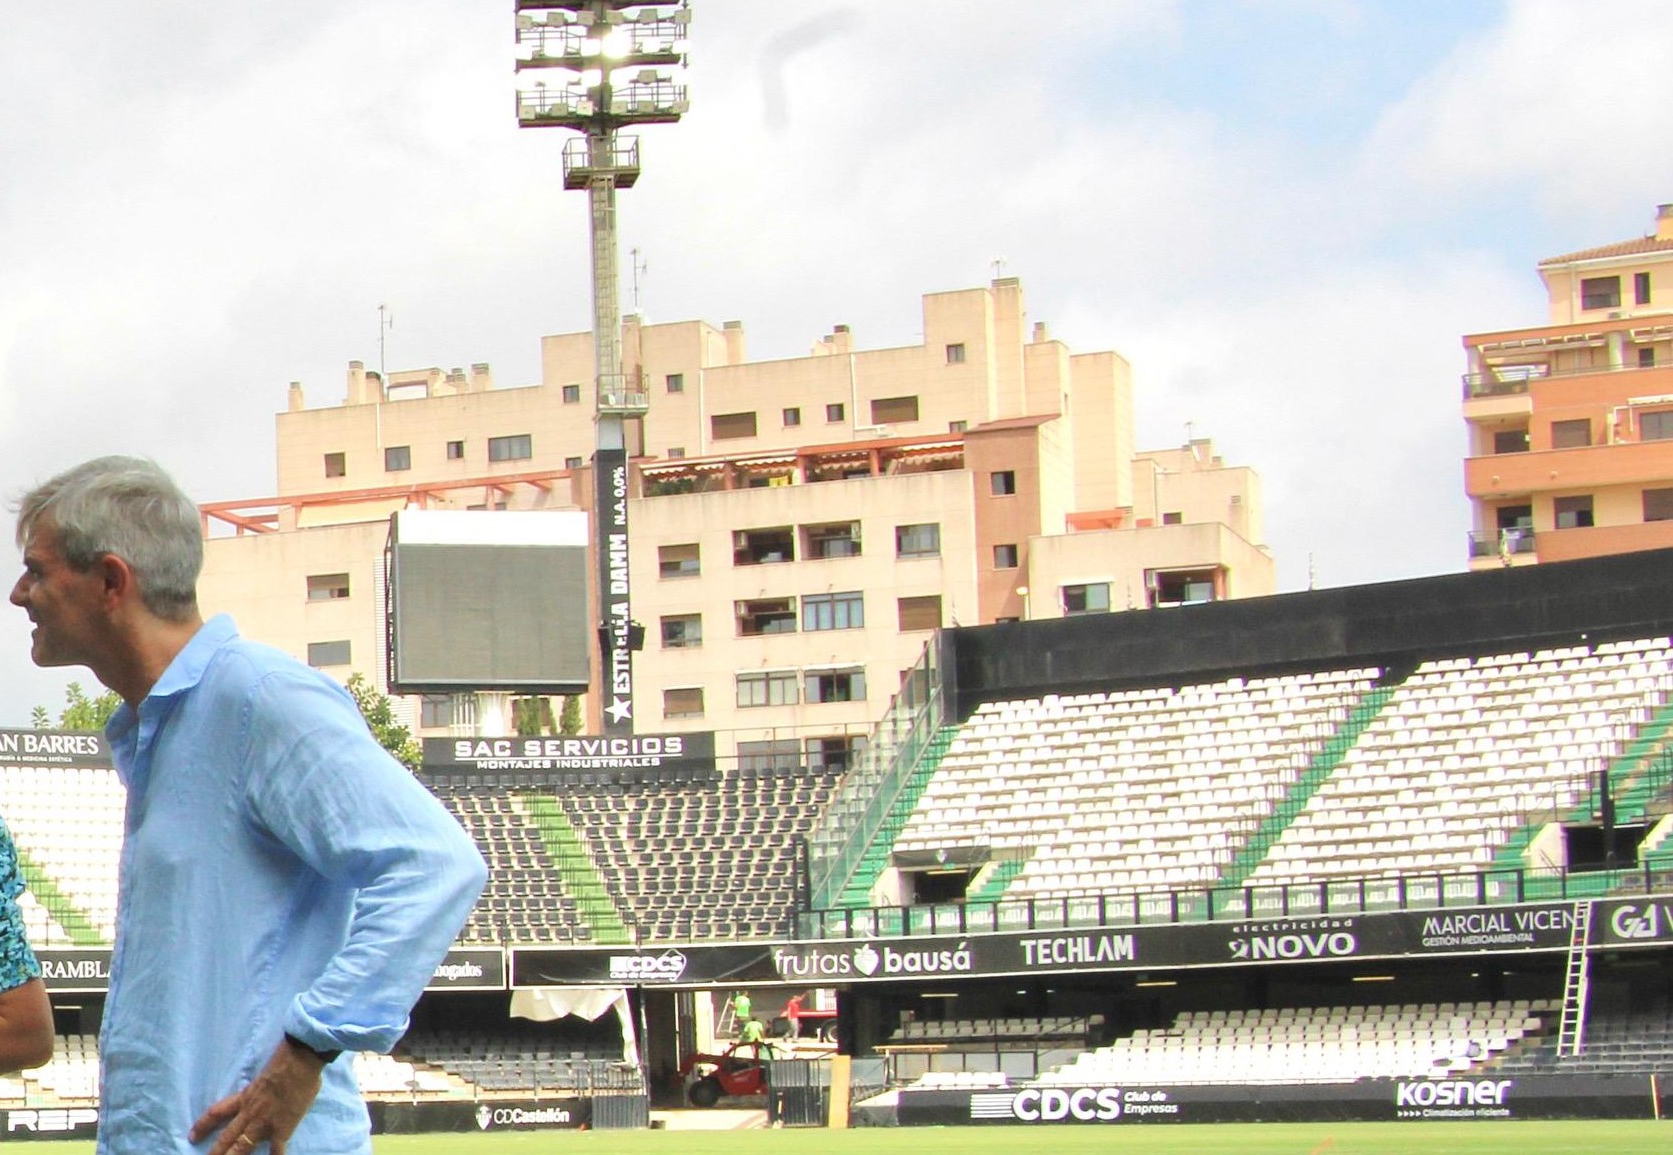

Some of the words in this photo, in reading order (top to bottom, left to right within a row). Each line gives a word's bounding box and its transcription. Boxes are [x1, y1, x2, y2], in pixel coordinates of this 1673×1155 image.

[613, 466, 627, 498] 0,0%
[614, 499, 626, 526] N.A.
[609, 534, 629, 595] DAMM
[23, 734, 99, 755] BARRES
[455, 740, 511, 757] SAC
[524, 736, 683, 757] SERVICIOS
[477, 759, 551, 770] MONTAJES
[556, 757, 661, 769] INDUSTRIALES
[1232, 919, 1353, 933] electricidad
[1422, 912, 1510, 936] MARCIAL
[1019, 934, 1135, 965] TECHLAM
[1251, 932, 1355, 959] NOVO
[1422, 935, 1459, 947] GESTIÓN
[1461, 933, 1534, 946] MEDIOAMBIENTAL
[627, 955, 684, 972] CDCS
[773, 949, 850, 975] frutas
[884, 941, 971, 973] bausá
[41, 960, 111, 979] RAMBL
[1012, 1088, 1121, 1121] CDCS
[1124, 1091, 1150, 1102] Club
[1151, 1091, 1167, 1102] de
[1124, 1104, 1178, 1116] Empresas
